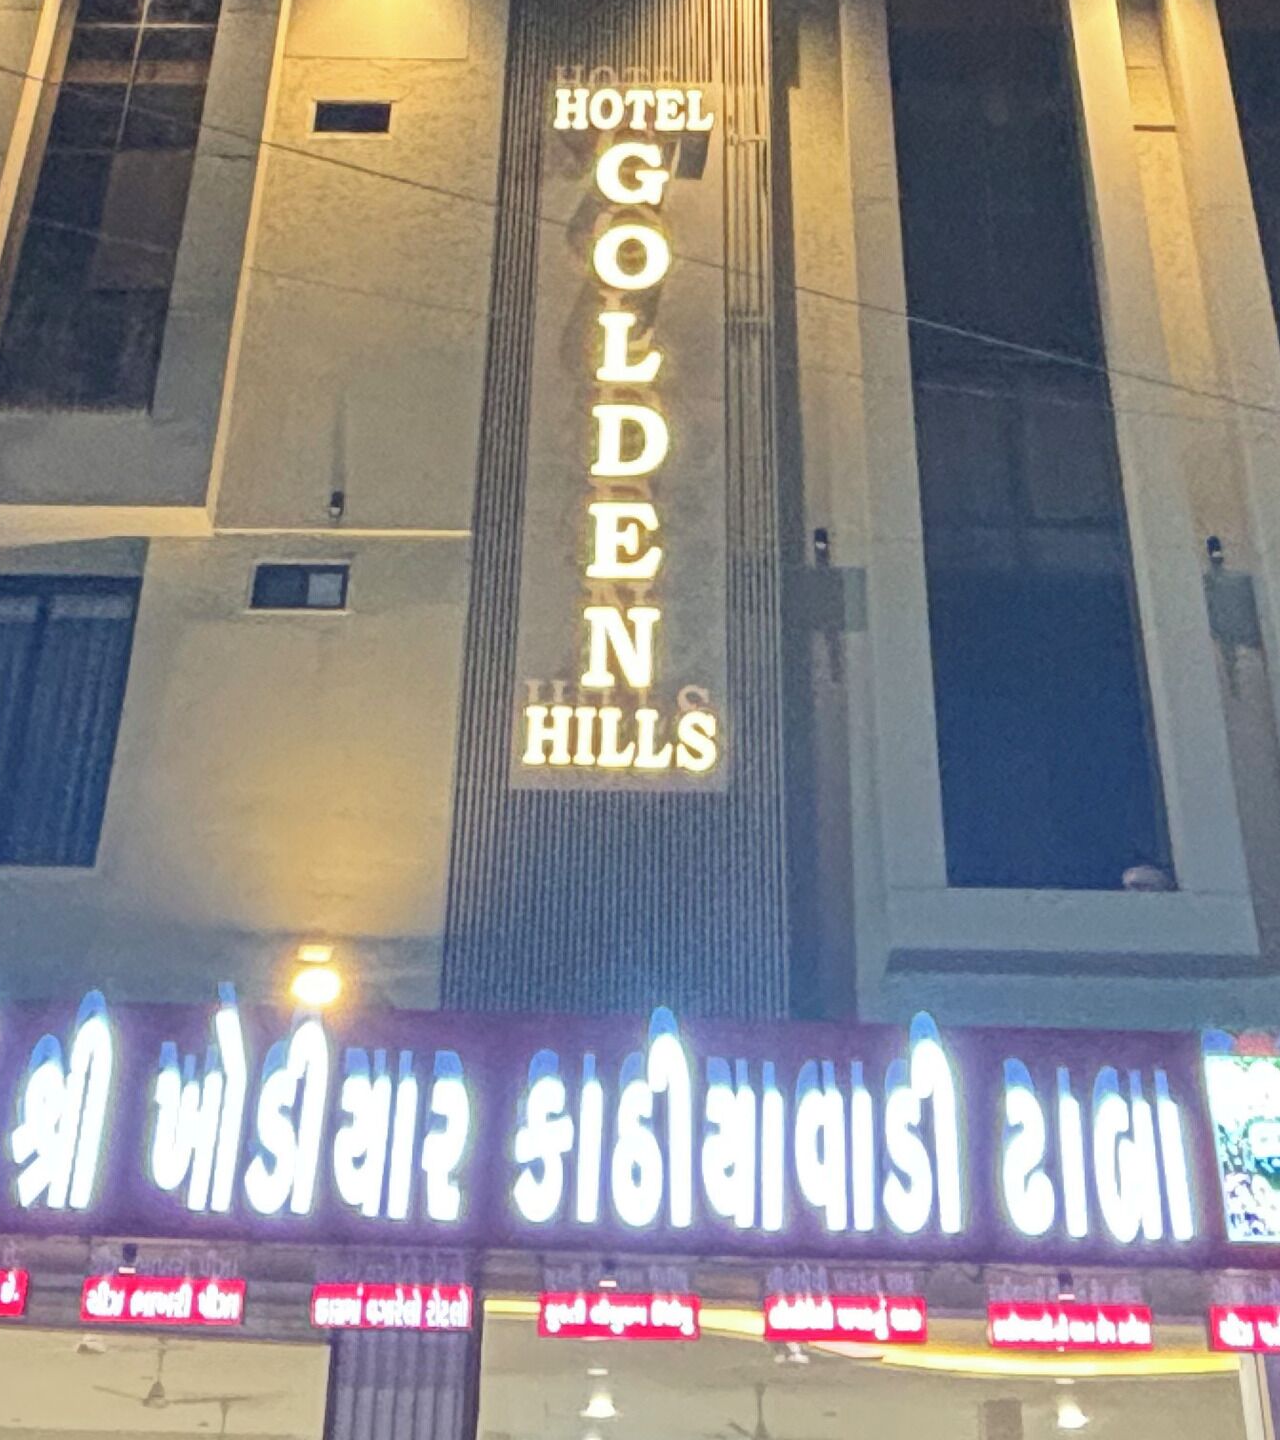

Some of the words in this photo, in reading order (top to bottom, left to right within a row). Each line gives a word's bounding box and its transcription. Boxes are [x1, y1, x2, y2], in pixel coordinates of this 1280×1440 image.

[552, 88, 714, 131] HOTEL
[580, 141, 673, 690] GOLDEN
[522, 704, 719, 773] HILLS
[9, 1005, 114, 1210] શ્રી
[149, 997, 472, 1222] ખોડીયાર
[510, 1020, 964, 1236] કાઠીયાવાડી
[1001, 1070, 1198, 1244] ઢાબા
